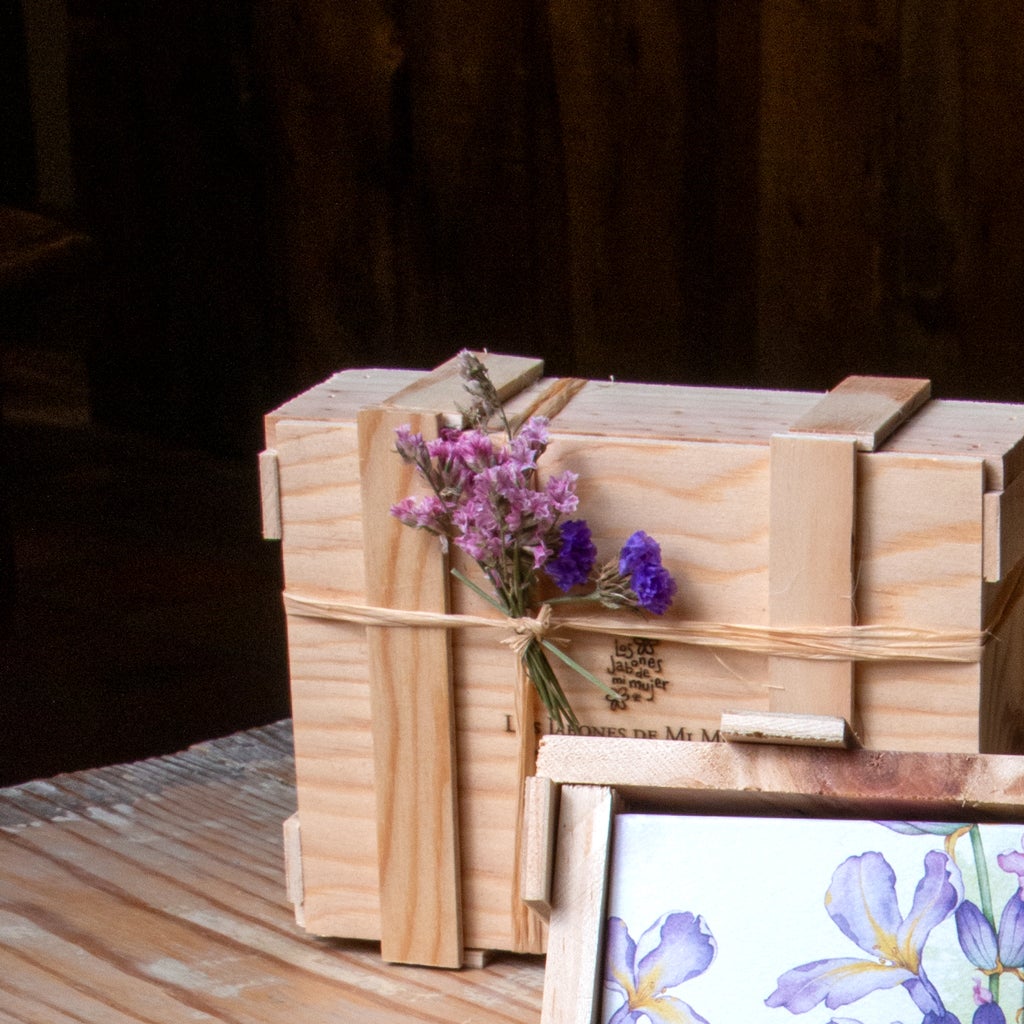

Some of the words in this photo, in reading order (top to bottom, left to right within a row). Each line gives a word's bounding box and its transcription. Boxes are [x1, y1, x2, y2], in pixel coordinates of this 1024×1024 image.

[615, 639, 633, 659] Los
[607, 655, 663, 674] Jabones
[635, 668, 650, 678] de
[612, 676, 625, 684] mi
[629, 678, 669, 701] mujer
